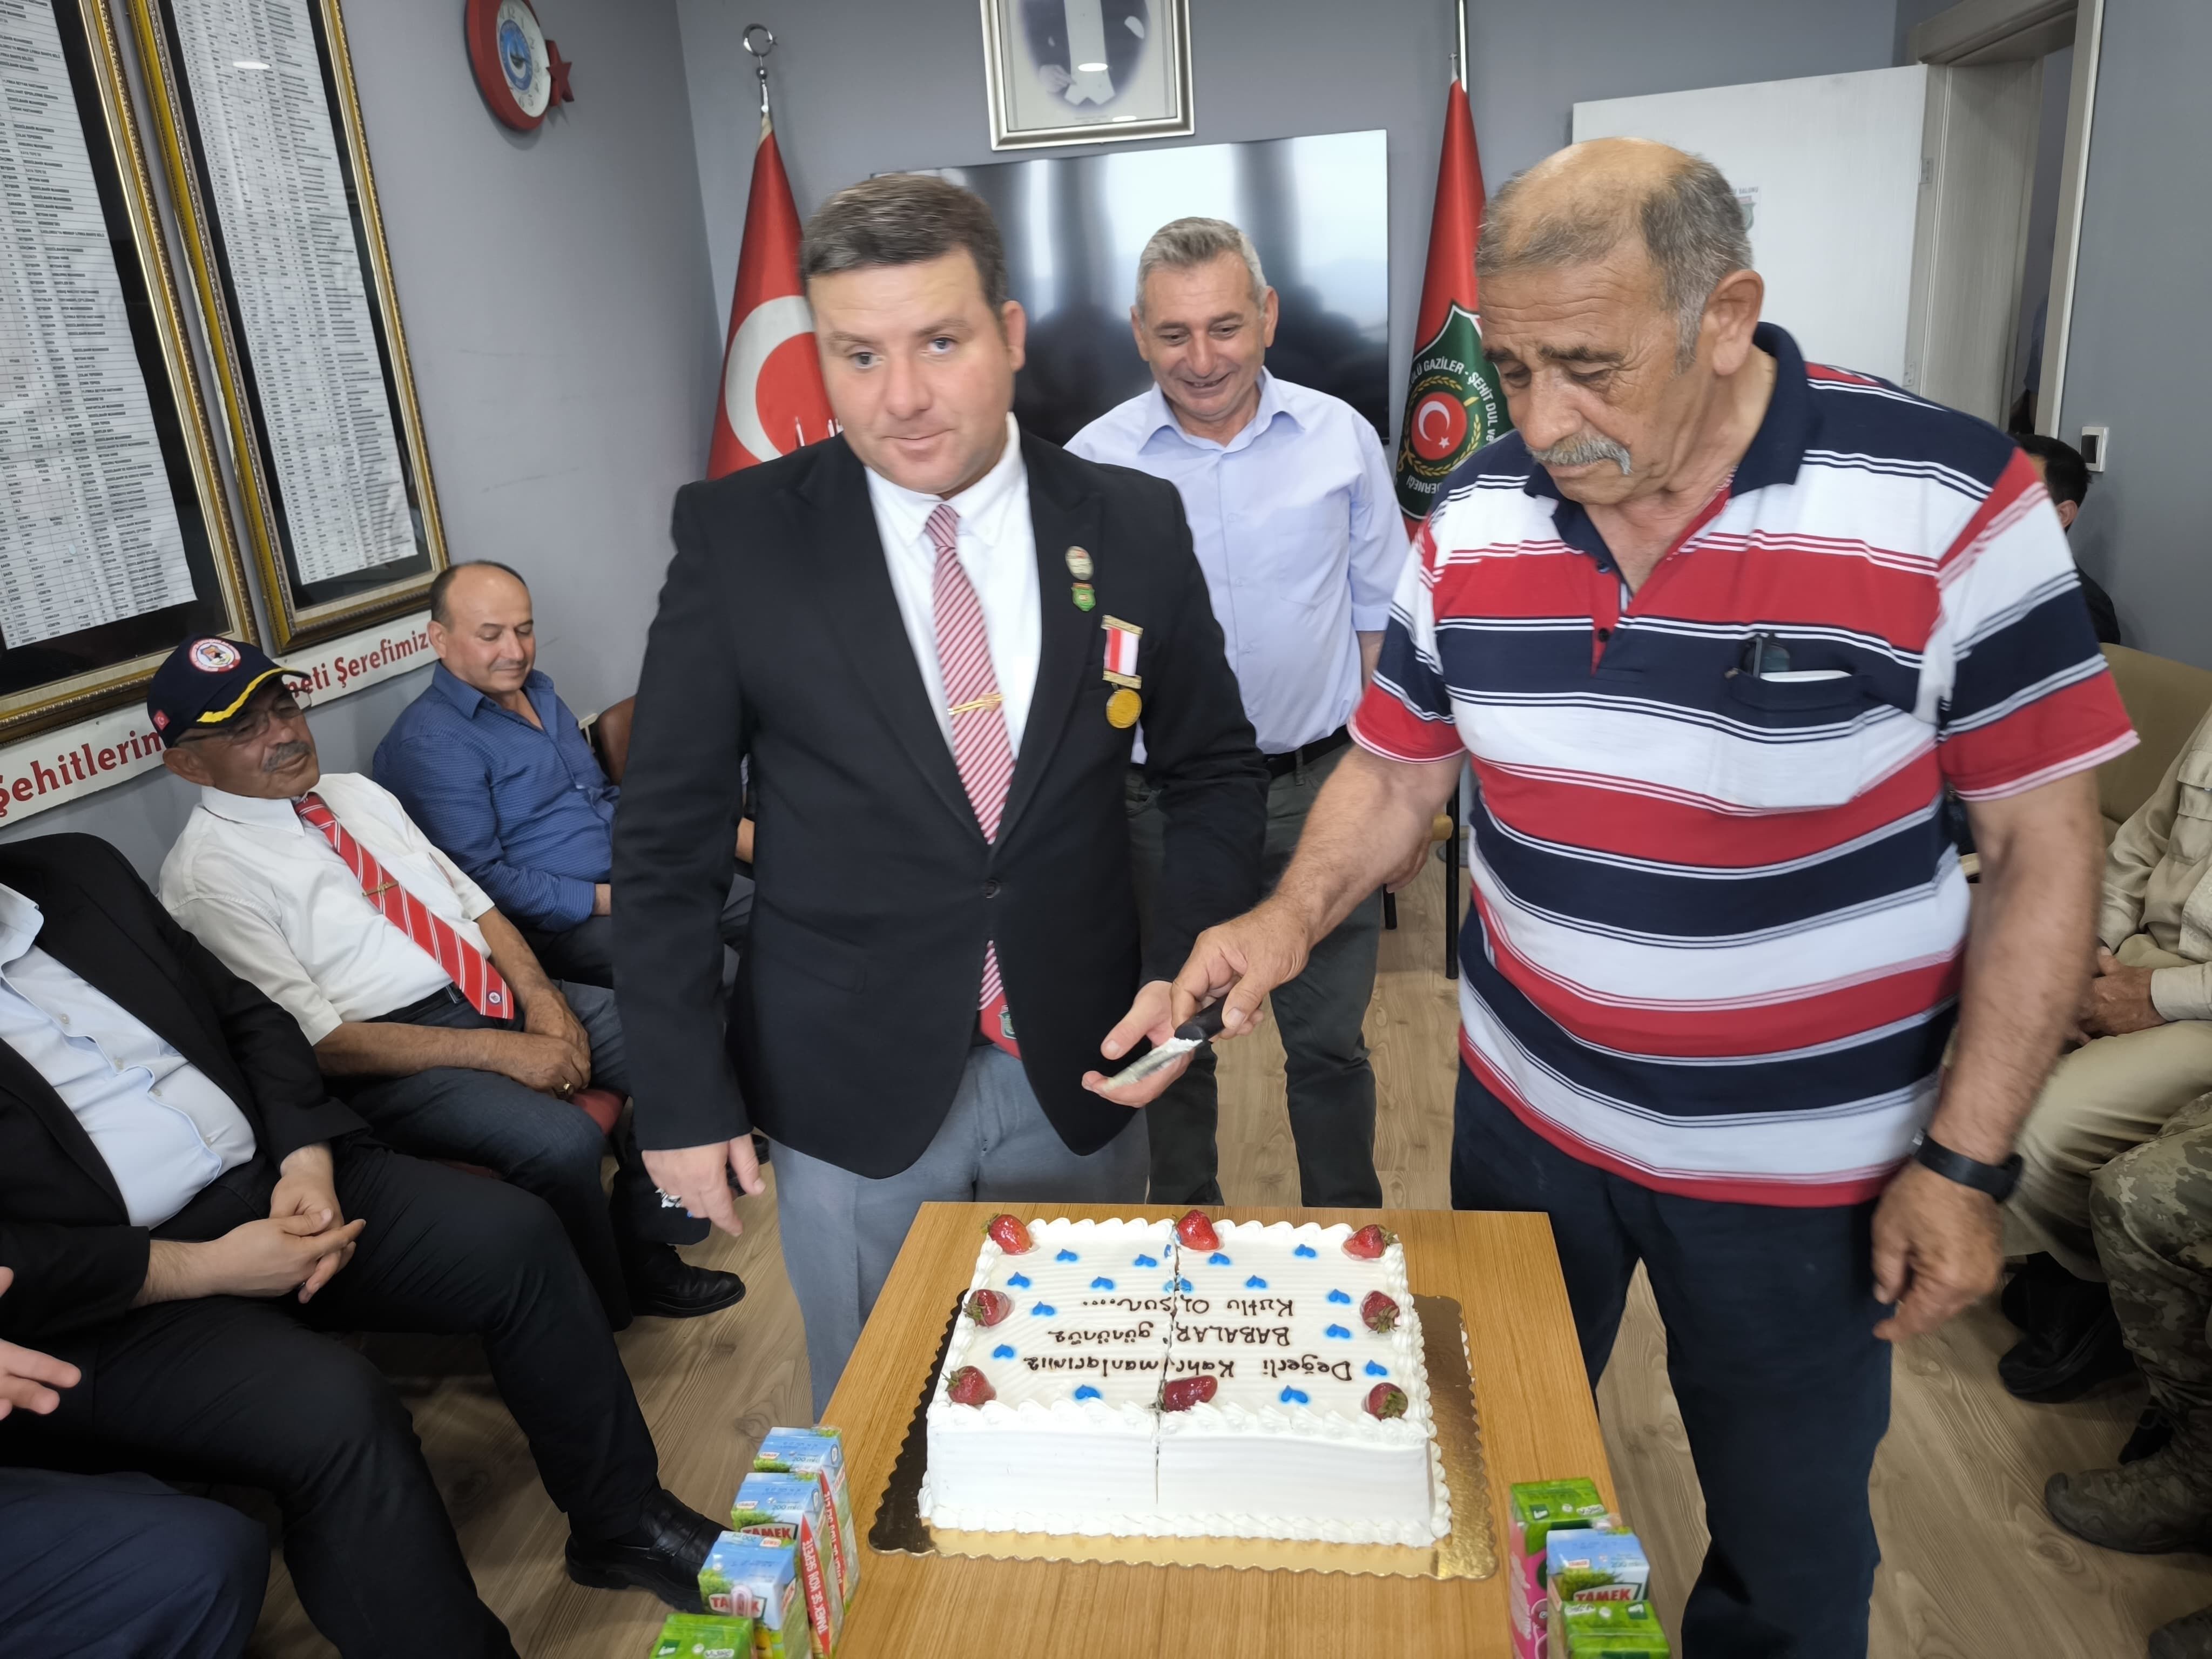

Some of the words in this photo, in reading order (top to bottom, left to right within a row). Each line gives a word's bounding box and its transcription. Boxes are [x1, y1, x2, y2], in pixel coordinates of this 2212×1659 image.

[1424, 356, 1465, 375] GAZİLER
[1467, 371, 1494, 402] ŞEHİT
[1486, 402, 1499, 427] DUL
[1486, 429, 1496, 442] ve
[334, 630, 433, 688] Şerefimiz
[1226, 1298, 1294, 1317] Kutlu
[1262, 1353, 1353, 1381] Değerli
[710, 1596, 760, 1613] TAK
[1575, 1588, 1632, 1602] TAMEK
